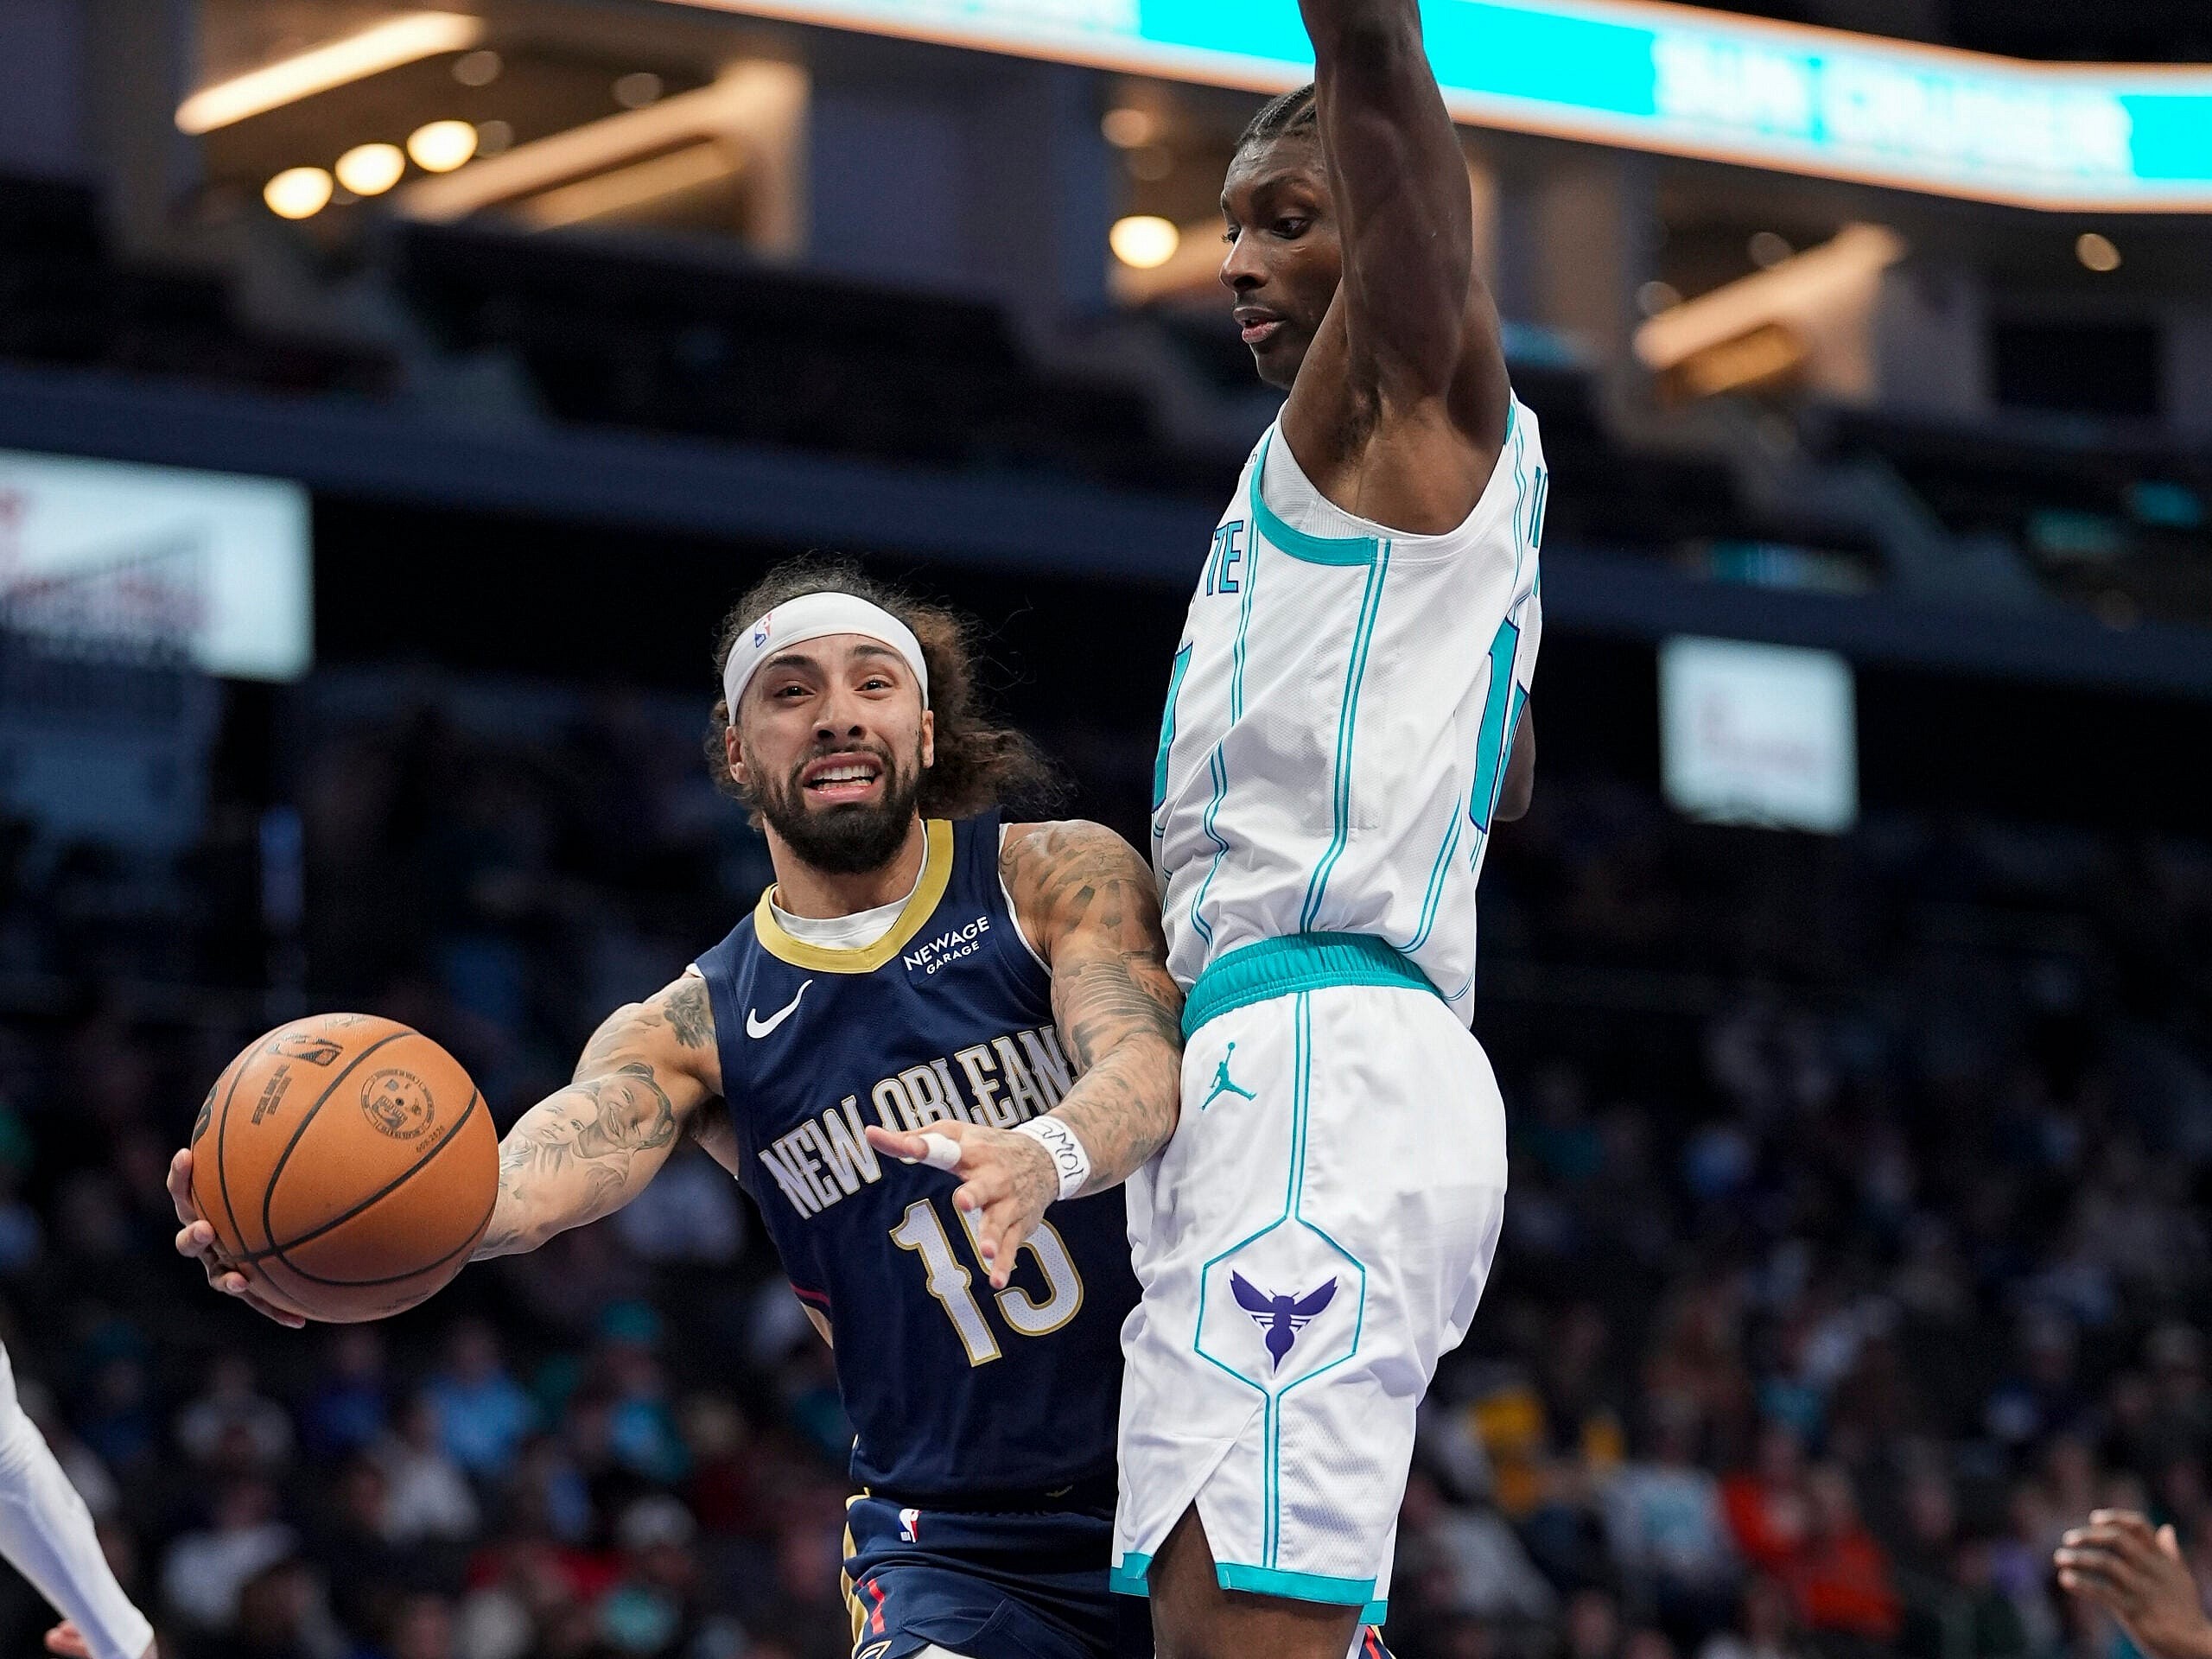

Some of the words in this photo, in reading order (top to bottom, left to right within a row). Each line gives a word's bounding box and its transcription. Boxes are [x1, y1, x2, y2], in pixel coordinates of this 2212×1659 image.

[903, 916, 990, 971] NEWAGE
[926, 940, 980, 975] GARAGE
[758, 1094, 882, 1220] NEW
[871, 1024, 1078, 1166] ORLEAN
[888, 1198, 1084, 1368] 15
